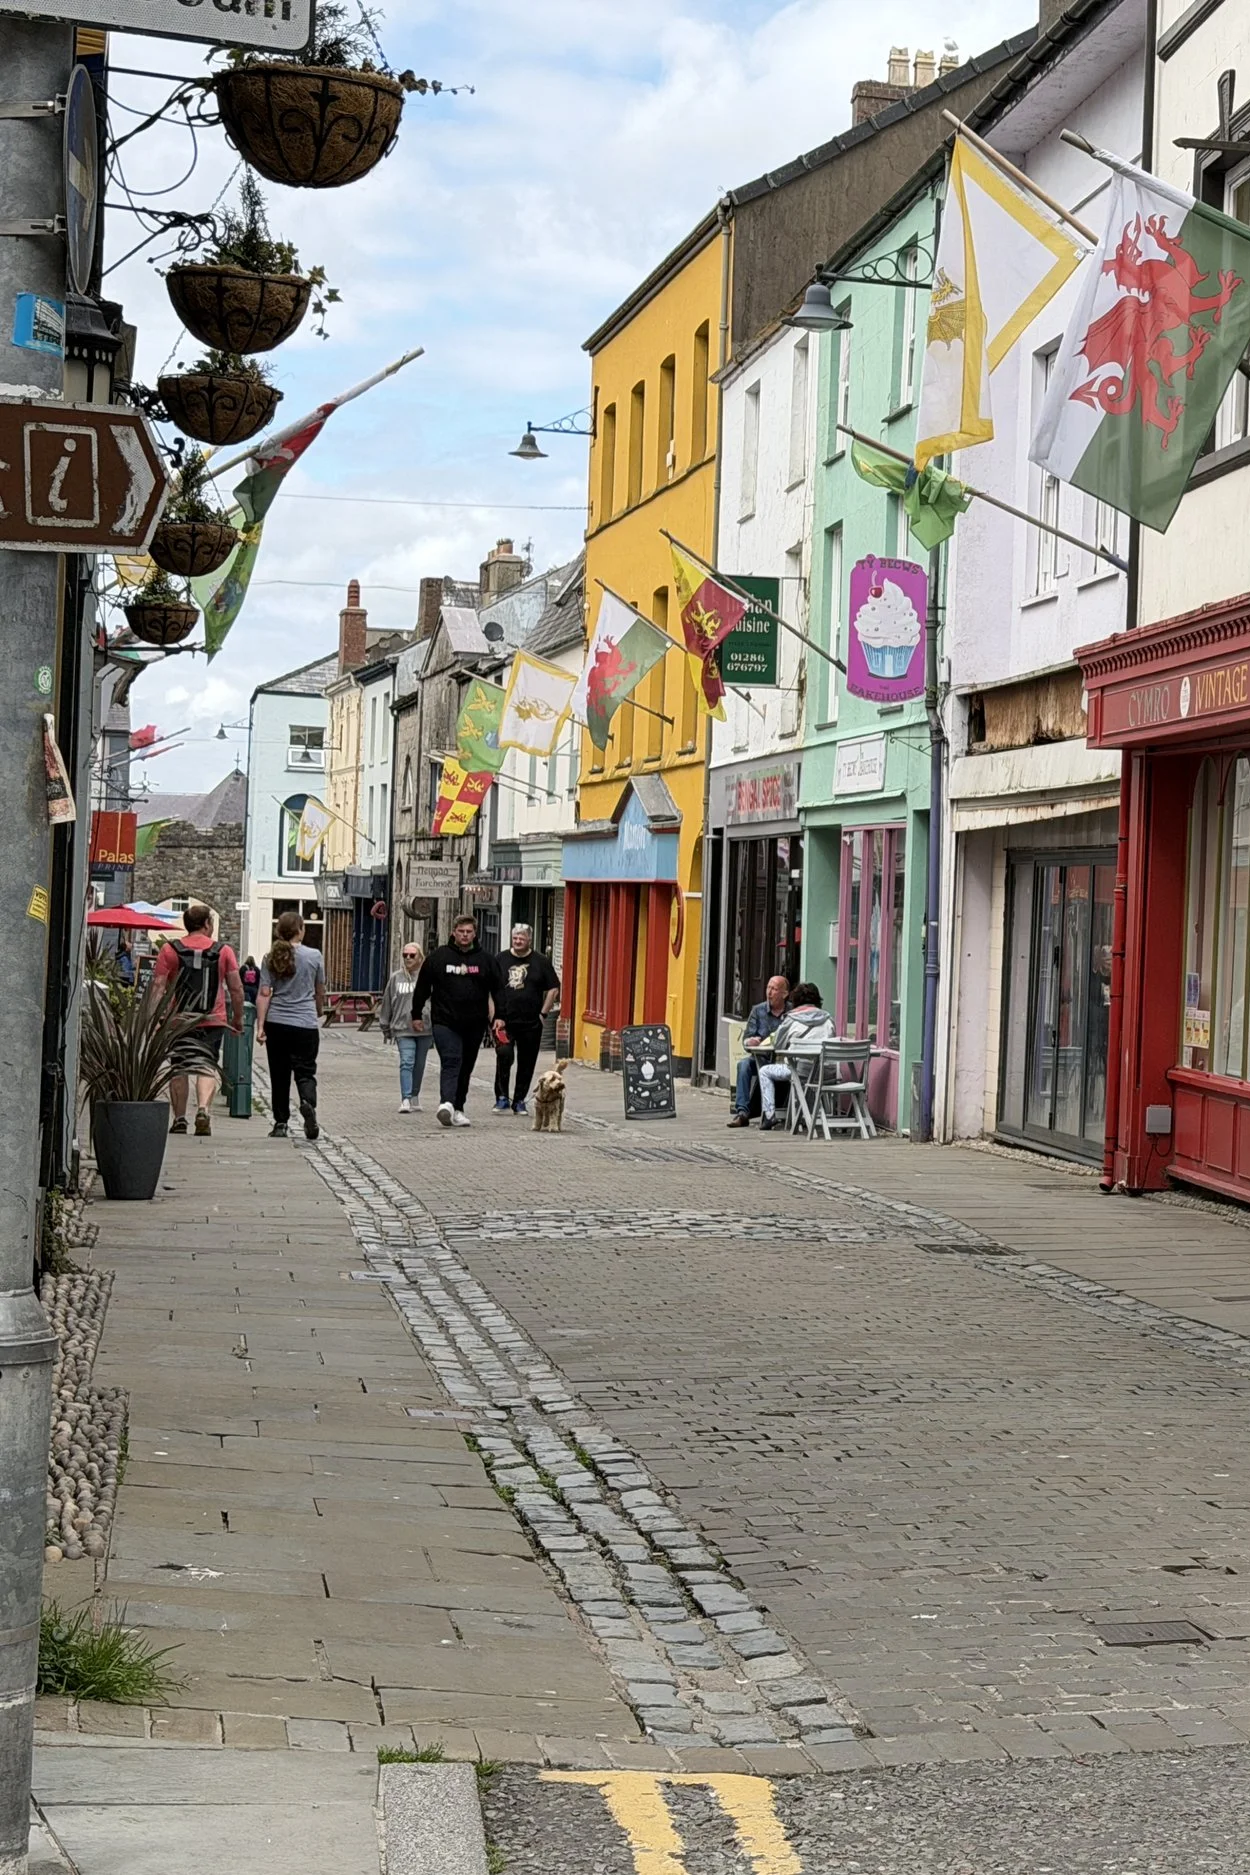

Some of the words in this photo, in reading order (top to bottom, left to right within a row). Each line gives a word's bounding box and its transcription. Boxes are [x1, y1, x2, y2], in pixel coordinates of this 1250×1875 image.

[734, 617, 771, 633] uisine
[730, 652, 766, 663] 01286
[726, 663, 768, 673] 676797
[1128, 685, 1170, 727] CYMRO
[1196, 664, 1249, 712] VINTAGE
[98, 849, 135, 864] Palas
